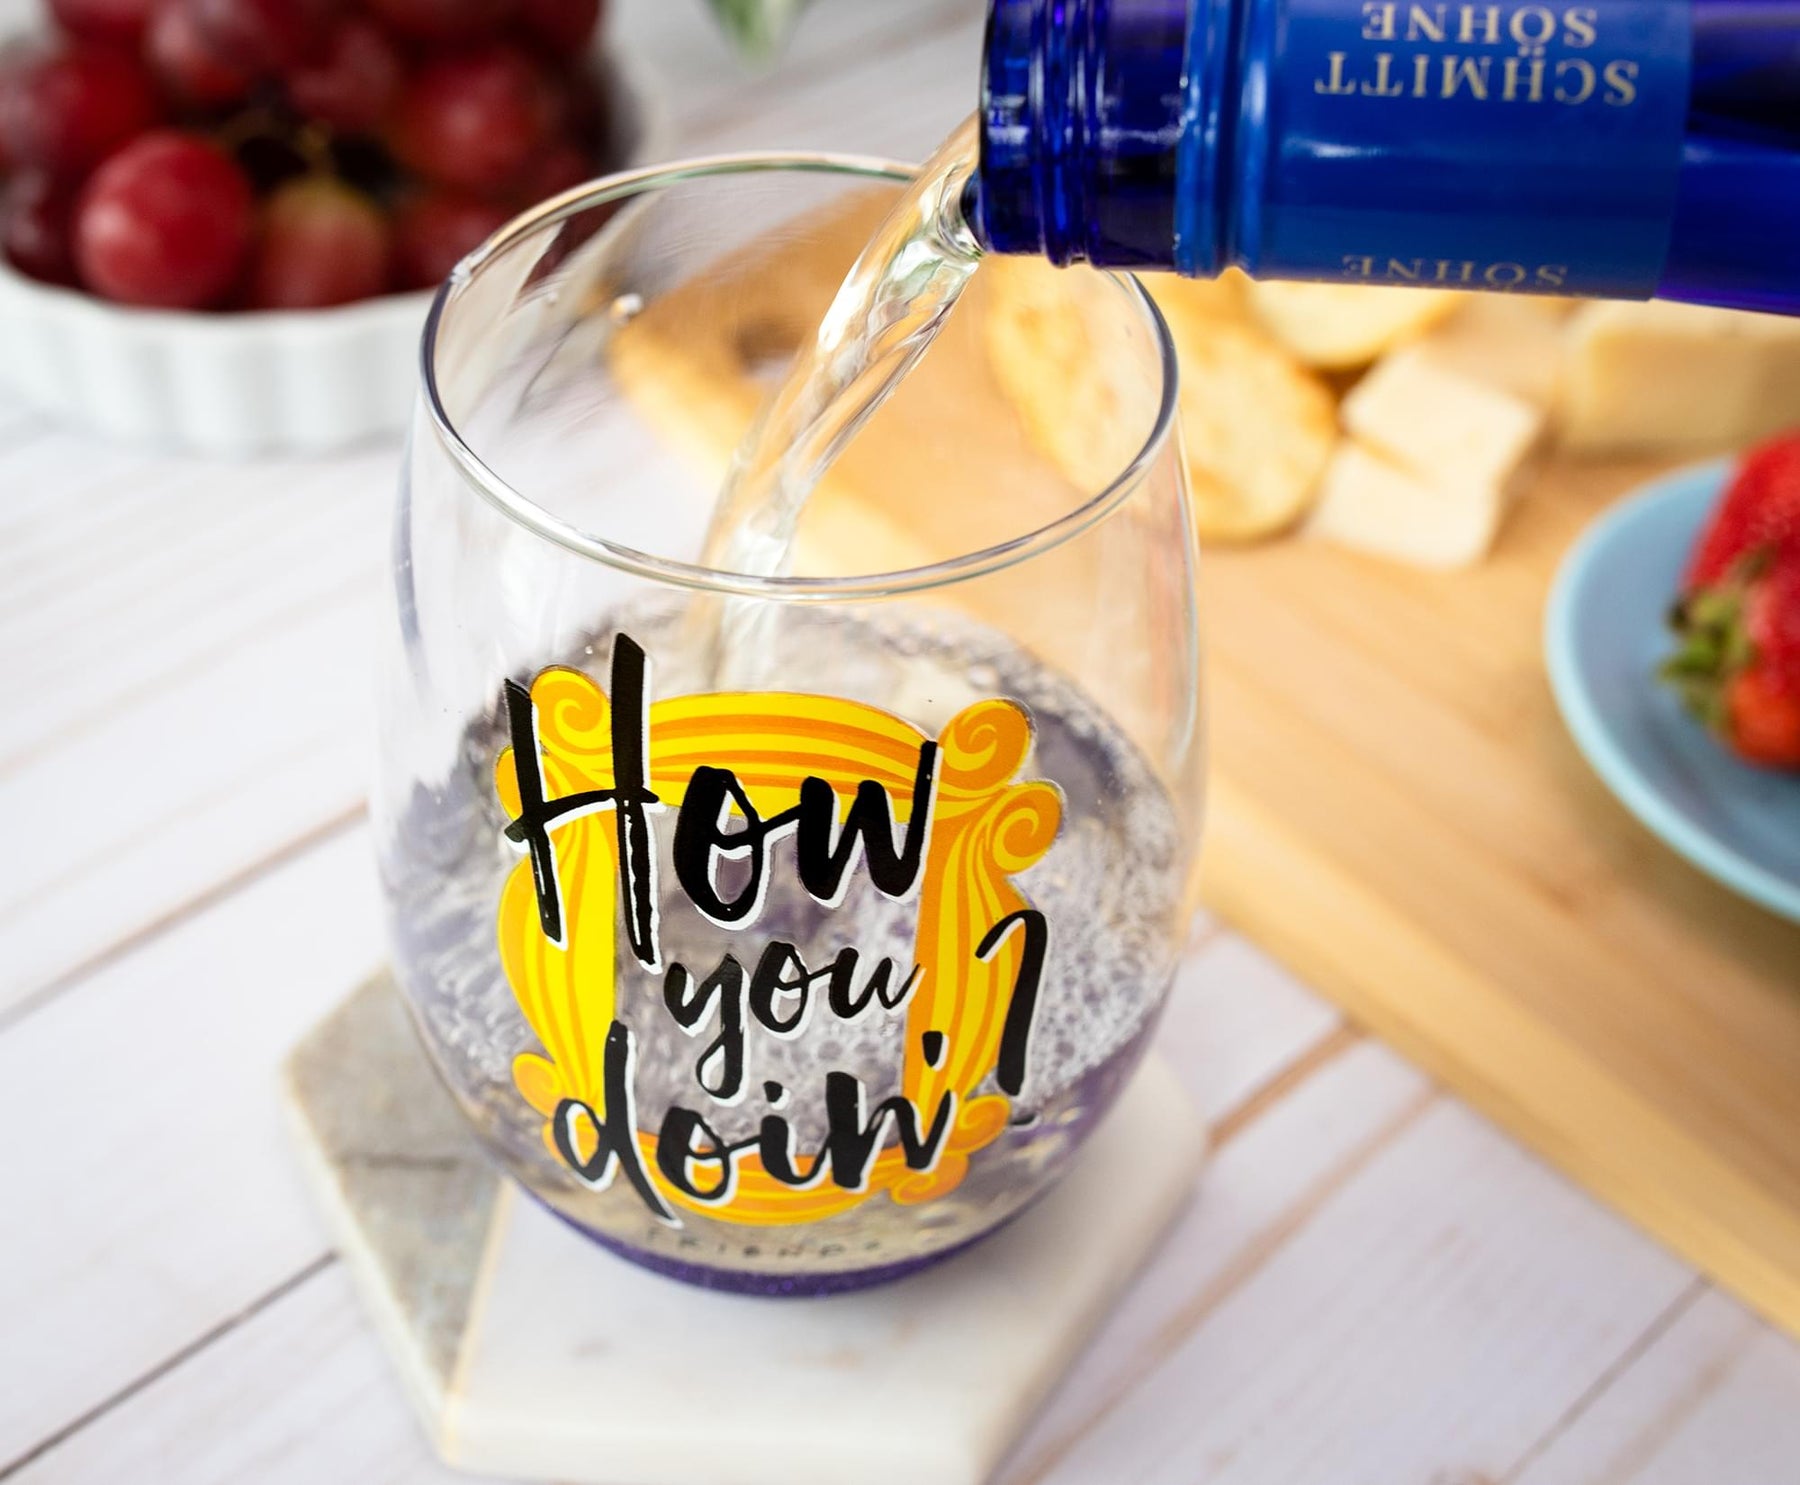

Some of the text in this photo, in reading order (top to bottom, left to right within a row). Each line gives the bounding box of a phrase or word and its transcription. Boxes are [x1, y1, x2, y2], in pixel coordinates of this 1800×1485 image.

[1314, 51, 1640, 106] SCHMITT
[1361, 2, 1598, 58] SÖHNE
[503, 632, 943, 972] How
[663, 940, 926, 1107] you
